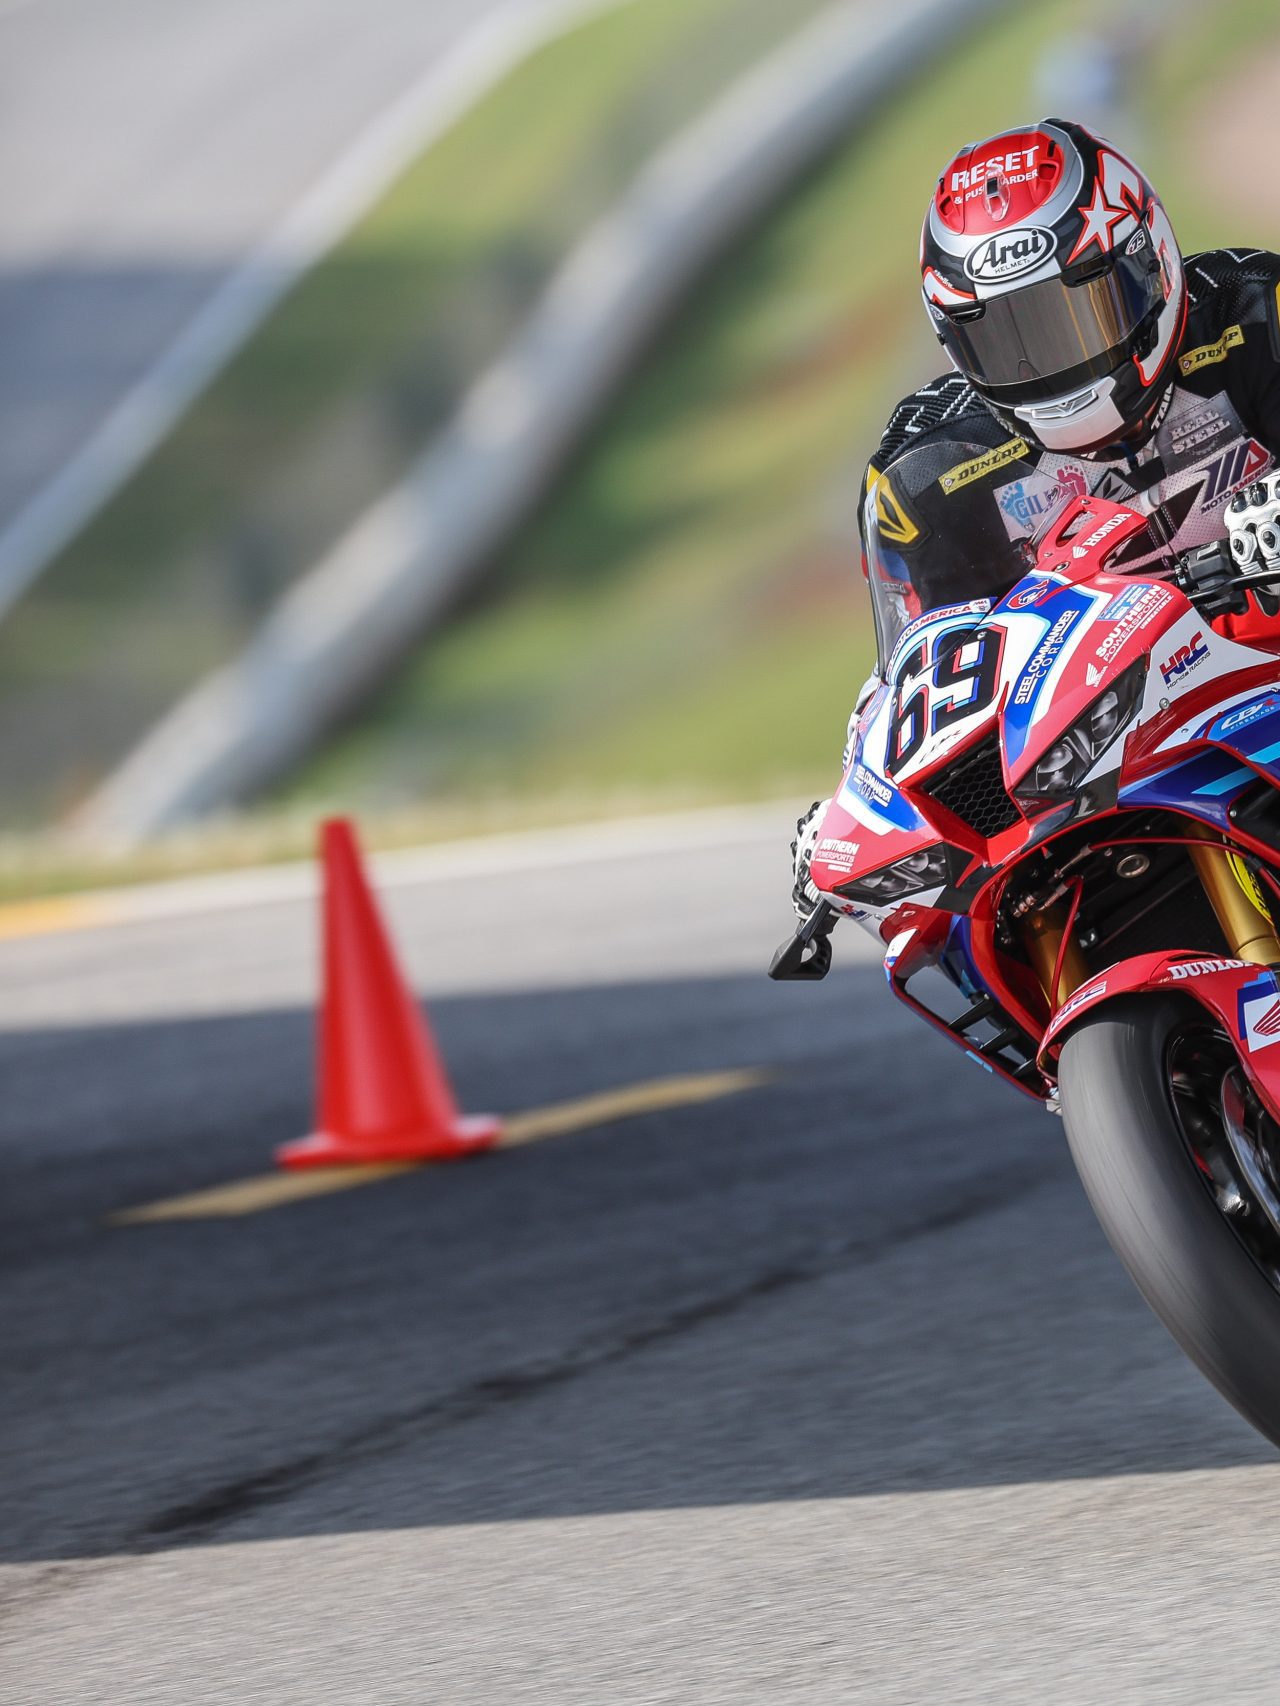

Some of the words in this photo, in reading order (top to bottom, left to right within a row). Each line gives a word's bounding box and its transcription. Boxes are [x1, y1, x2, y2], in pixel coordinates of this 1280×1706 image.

[951, 145, 1040, 191] RESET
[965, 186, 986, 202] PUS
[1001, 168, 1039, 186] ARDER
[973, 229, 1044, 276] Arai
[994, 258, 1028, 275] HELMET
[1170, 409, 1220, 442] REAL
[1172, 418, 1231, 455] STEEL
[957, 442, 1022, 482] DUNLOP
[1083, 513, 1132, 547] HONDA
[1095, 584, 1162, 657] SOUTHERN
[1103, 588, 1167, 662] POWERSPORTS
[1014, 672, 1035, 704] STEEL
[1028, 610, 1076, 673] COMMANDER
[1036, 635, 1065, 678] CORP
[1159, 631, 1209, 685] HRC
[1166, 671, 1190, 691] Honda
[1188, 651, 1211, 673] RACING
[884, 622, 1008, 779] 69
[864, 771, 893, 803] COMMANDER
